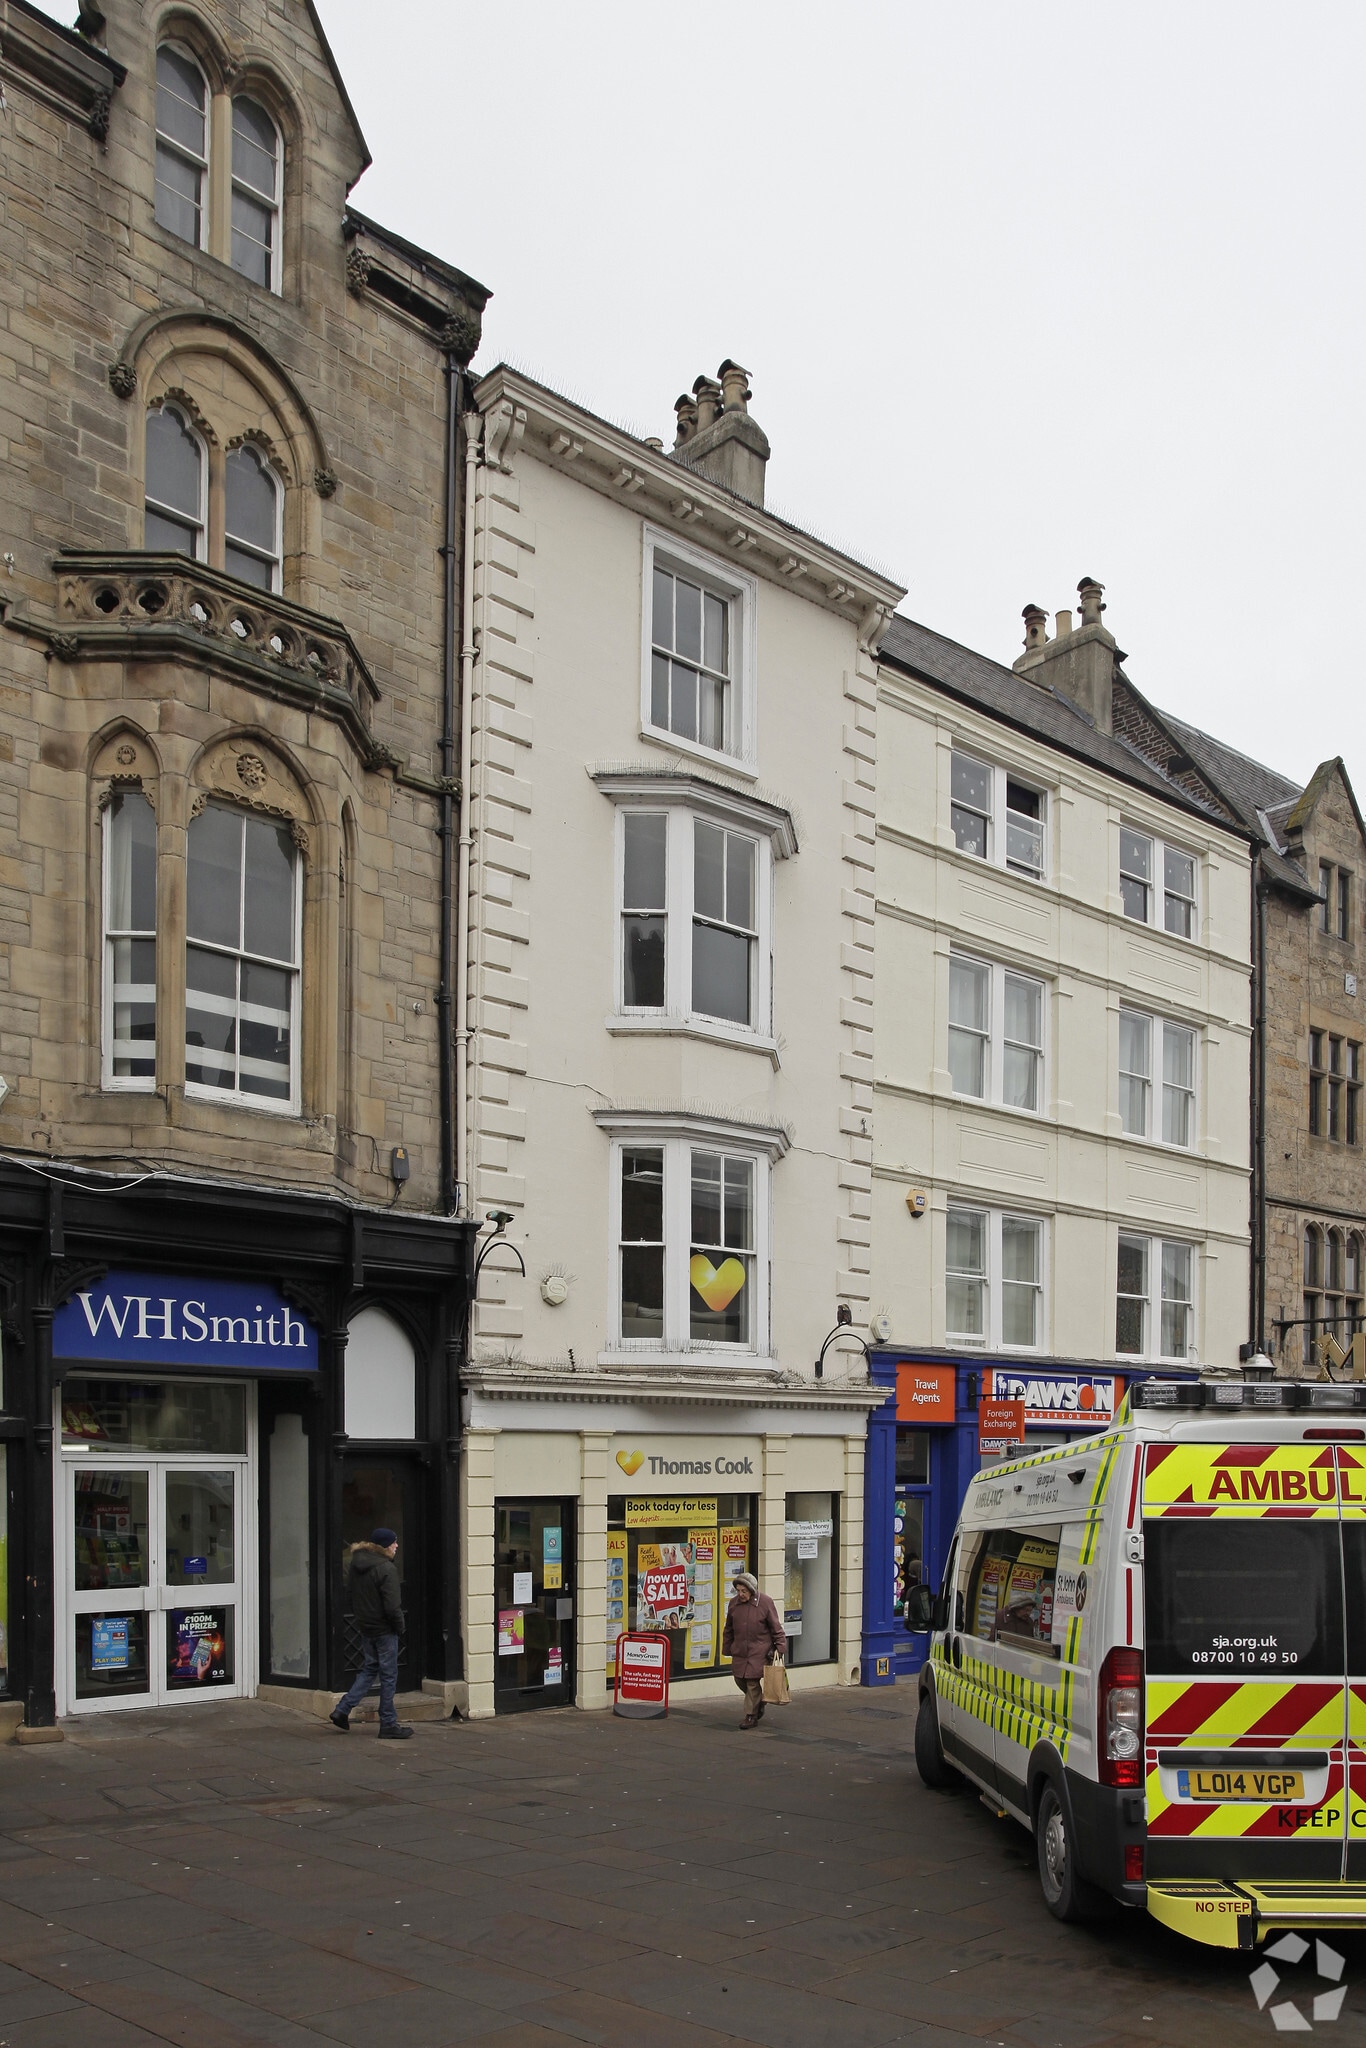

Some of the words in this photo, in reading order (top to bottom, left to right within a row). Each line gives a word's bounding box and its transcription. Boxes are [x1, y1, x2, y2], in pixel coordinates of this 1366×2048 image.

[76, 1292, 308, 1347] WHSmith
[914, 1378, 938, 1390] Travel
[912, 1392, 940, 1405] Agents
[1008, 1379, 1112, 1410] DAWSON
[987, 1410, 1014, 1420] Foreign
[984, 1420, 1016, 1430] Exchange
[648, 1456, 712, 1474] Thomas
[715, 1456, 753, 1474] Cook
[1208, 1470, 1366, 1501] AMBUL
[627, 1501, 650, 1512] Book
[653, 1501, 680, 1514] today
[682, 1500, 696, 1510] for
[698, 1500, 716, 1510] less
[640, 1514, 660, 1524] deposits
[607, 1540, 625, 1550] ALS
[690, 1537, 716, 1546] DEALS
[722, 1534, 748, 1544] DEALS
[648, 1575, 670, 1584] now
[672, 1574, 684, 1582] on
[1063, 1576, 1075, 1592] John
[647, 1583, 685, 1601] SALE
[185, 1615, 212, 1624] £100M
[190, 1622, 218, 1630] PRIZES
[1212, 1635, 1278, 1649] sja.org.uk
[1192, 1651, 1234, 1663] 08700
[1240, 1652, 1255, 1663] 10
[1260, 1652, 1276, 1663] 49
[1282, 1652, 1298, 1663] 50
[1197, 1773, 1246, 1793] LO14
[1253, 1774, 1296, 1794] VGP
[1278, 1809, 1340, 1827] KEEP
[1196, 1902, 1214, 1912] NO
[1218, 1902, 1250, 1912] STEP
